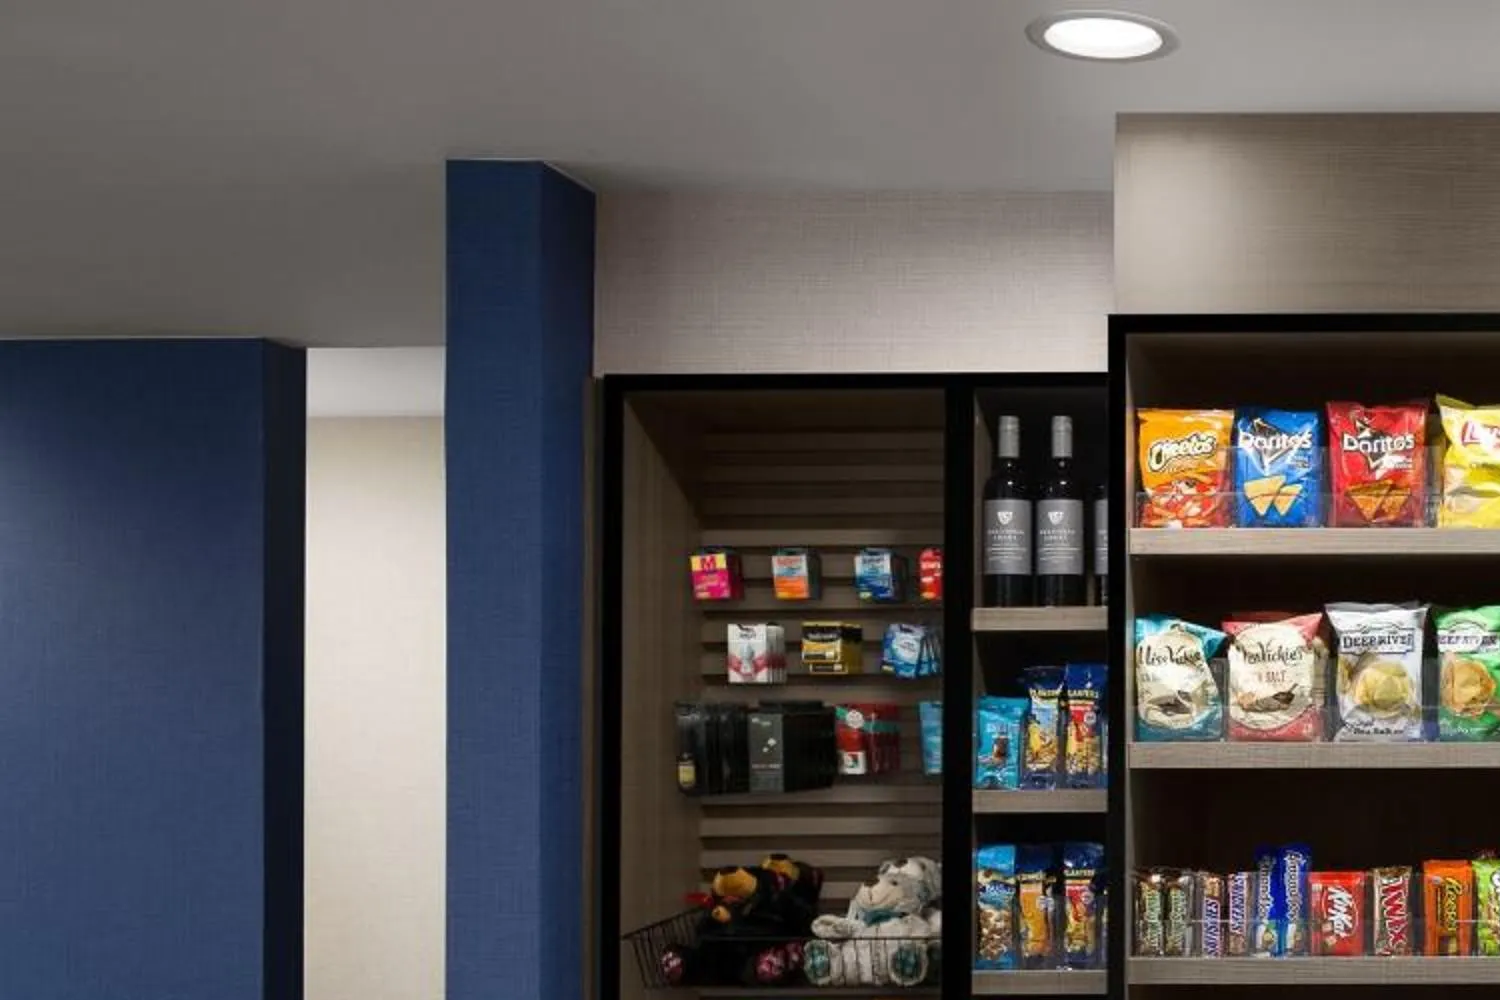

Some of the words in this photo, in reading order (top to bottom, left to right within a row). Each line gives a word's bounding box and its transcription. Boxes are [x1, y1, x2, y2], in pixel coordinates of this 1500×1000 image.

[1148, 430, 1218, 473] Cheetos
[1237, 430, 1316, 451] Doritos
[1341, 432, 1415, 454] Doritos
